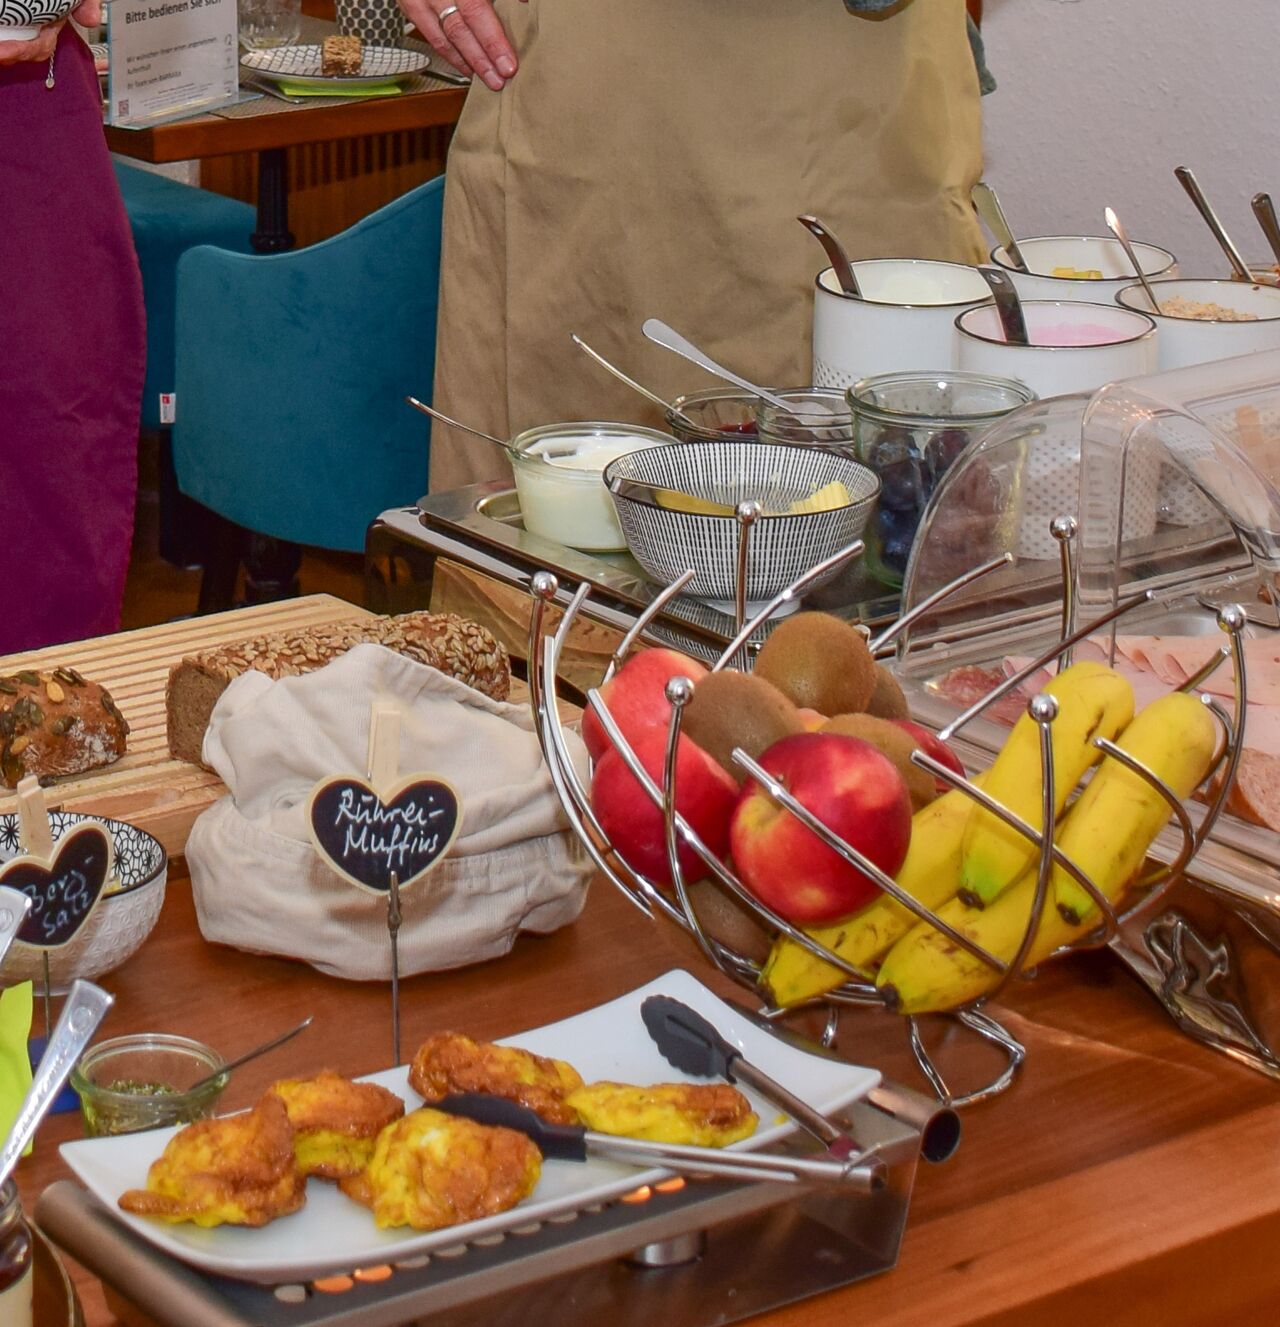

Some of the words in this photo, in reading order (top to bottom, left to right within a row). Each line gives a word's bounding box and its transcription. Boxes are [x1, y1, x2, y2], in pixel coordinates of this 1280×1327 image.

[125, 9, 147, 25] Bitte
[148, 3, 189, 19] bedienen
[343, 823, 439, 868] Muffins
